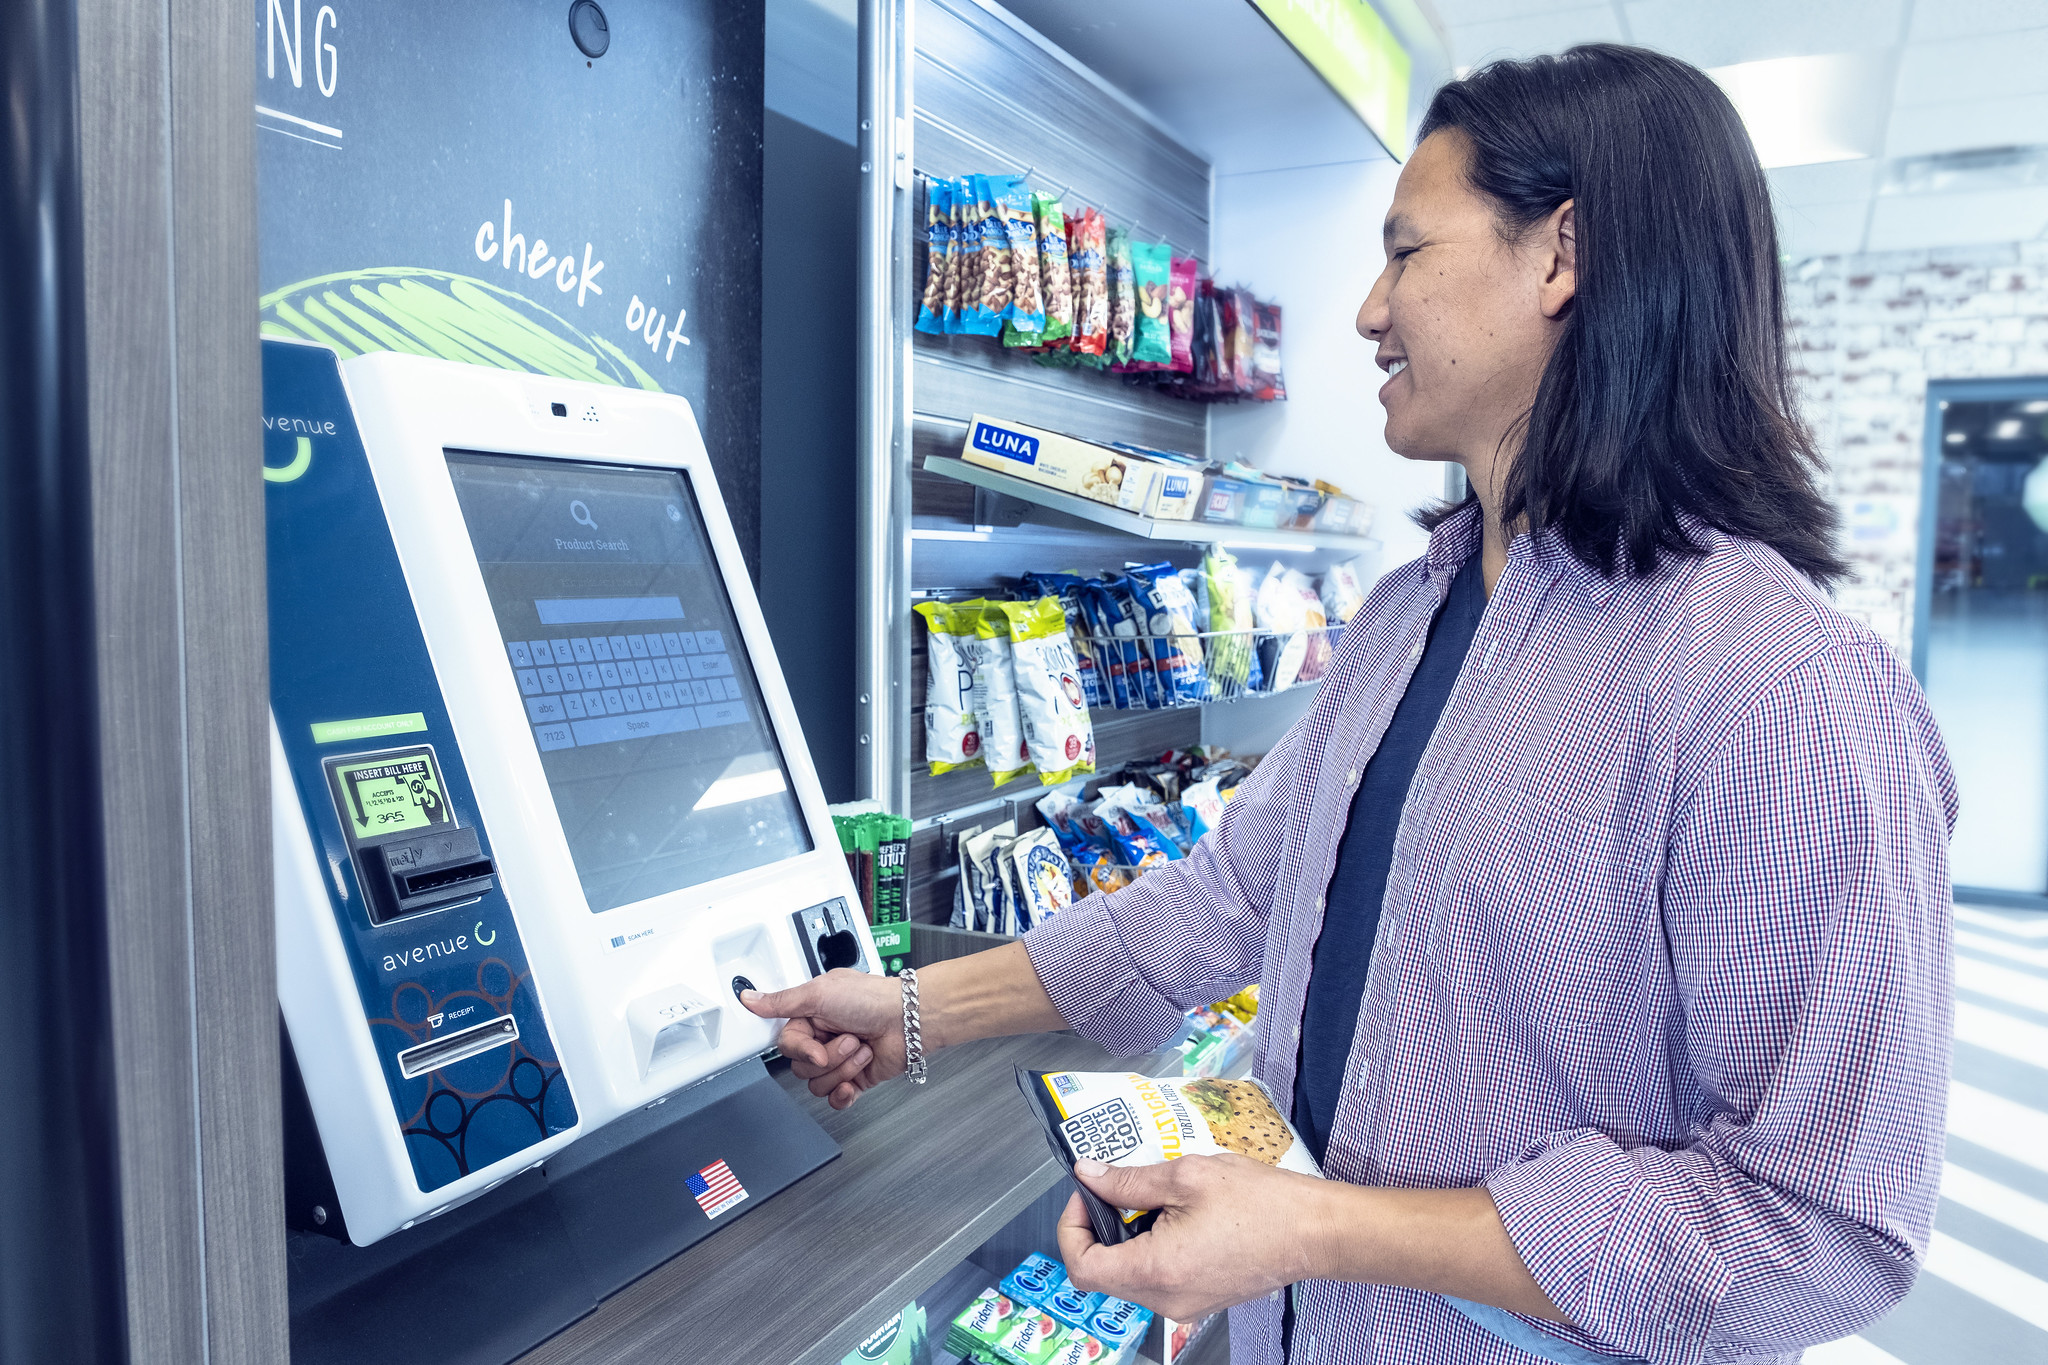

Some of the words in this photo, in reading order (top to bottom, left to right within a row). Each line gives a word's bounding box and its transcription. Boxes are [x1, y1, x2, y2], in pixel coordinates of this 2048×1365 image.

[474, 198, 605, 307] check
[625, 295, 691, 362] out
[980, 428, 1032, 457] LUNA
[1166, 478, 1187, 493] LUNA
[555, 538, 595, 551] Product
[596, 539, 629, 551] Search
[517, 648, 524, 658] Q
[536, 647, 546, 657] W
[559, 646, 566, 655] E
[579, 645, 586, 654] R
[598, 643, 604, 653] T
[616, 642, 622, 651] Y
[634, 641, 640, 650] U
[526, 676, 533, 686] A
[547, 674, 554, 684] S
[567, 673, 574, 682] D
[587, 671, 593, 680] F
[606, 670, 613, 679] G
[625, 668, 632, 677] H
[661, 665, 667, 674] K
[538, 703, 554, 714] abc
[570, 700, 578, 710] Z
[590, 698, 598, 708] X
[609, 696, 616, 705] C
[628, 694, 634, 703] V
[646, 692, 653, 701] B
[664, 690, 670, 699] N
[680, 688, 688, 697] M
[544, 730, 566, 742] ?123
[627, 721, 650, 732] Space
[353, 768, 383, 781] INSERT
[384, 766, 402, 776] BILL
[402, 762, 424, 774] HERE
[372, 789, 395, 798] ACCEPTS
[627, 932, 641, 942] SCAN
[641, 928, 654, 937] HERE
[383, 935, 469, 971] avenue
[448, 1005, 475, 1020] RECEIPT
[1158, 1083, 1179, 1103] CHIPS
[1092, 1108, 1122, 1156] TASTE
[1107, 1102, 1138, 1151] GOOD
[1171, 1102, 1196, 1141] TORTILLA
[1065, 1119, 1097, 1160] OOD
[1079, 1113, 1110, 1160] SHOULD
[1014, 1260, 1057, 1294] Orbit
[970, 1299, 996, 1333] Trident
[1091, 1301, 1137, 1336] Orbit
[1012, 1318, 1039, 1354] Trident
